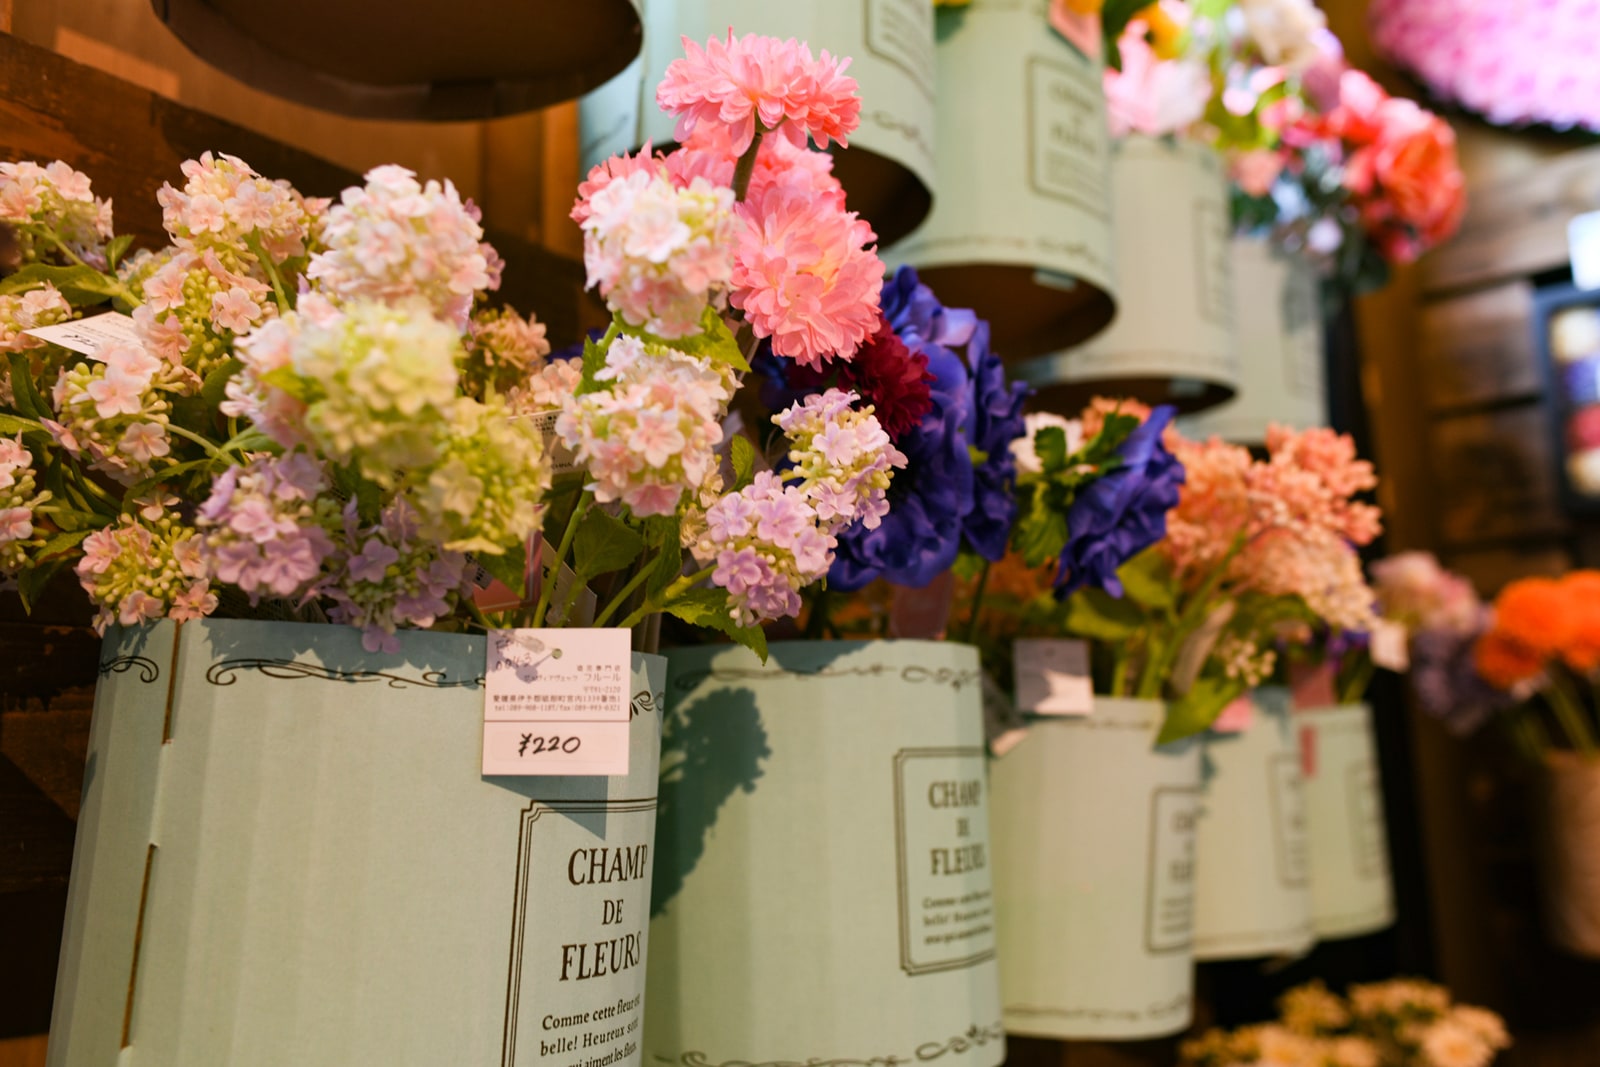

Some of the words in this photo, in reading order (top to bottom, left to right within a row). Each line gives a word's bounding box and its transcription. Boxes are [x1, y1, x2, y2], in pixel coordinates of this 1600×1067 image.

[568, 844, 648, 886] CHAMP
[601, 898, 624, 926] DE
[559, 930, 641, 982] FLEURS
[542, 1012, 590, 1031] Comme
[592, 1006, 616, 1021] cette
[540, 1035, 579, 1057] belle!
[582, 1025, 625, 1048] Heureux
